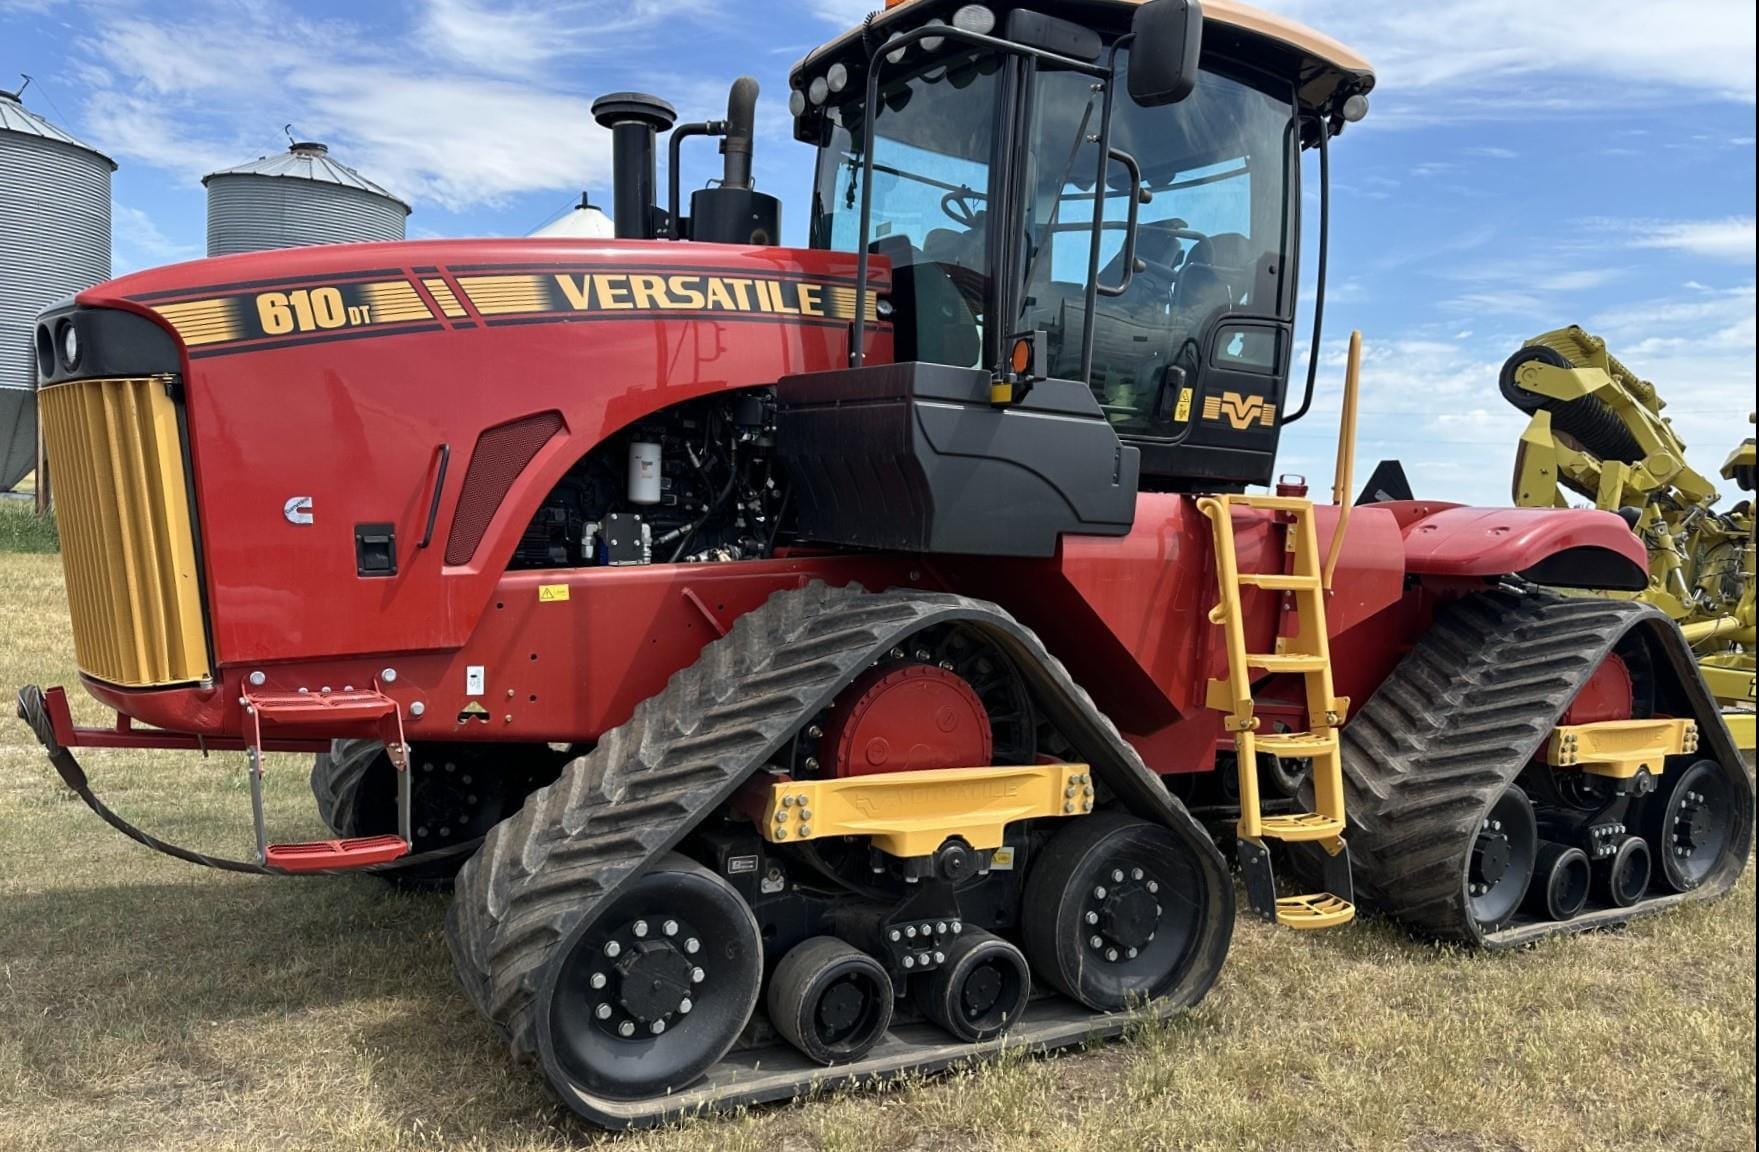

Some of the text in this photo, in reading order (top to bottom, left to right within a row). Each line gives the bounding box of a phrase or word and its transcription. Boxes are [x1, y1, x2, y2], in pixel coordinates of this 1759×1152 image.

[256, 287, 371, 335] 610 DT
[554, 274, 824, 316] VERSATILE
